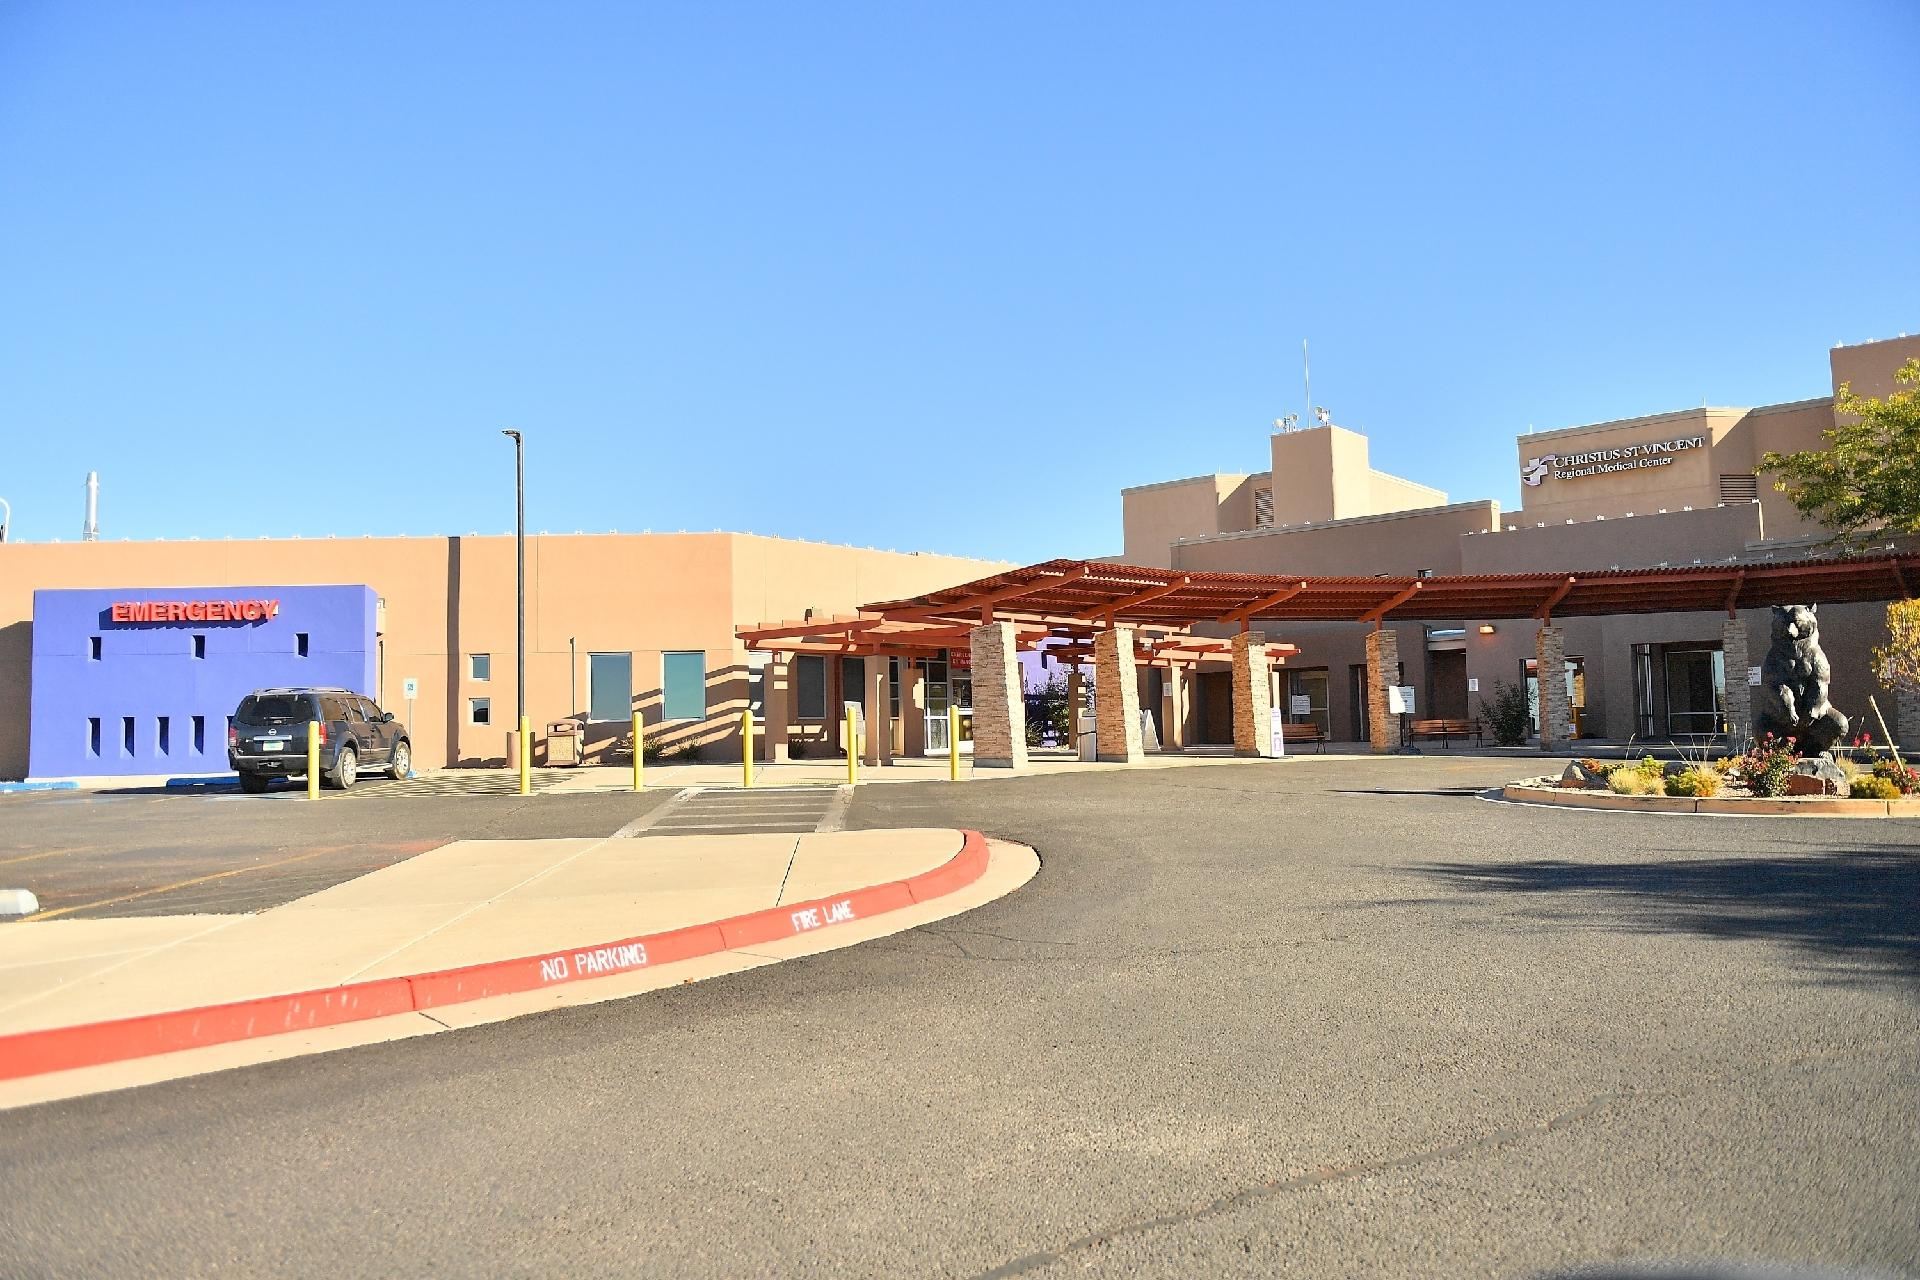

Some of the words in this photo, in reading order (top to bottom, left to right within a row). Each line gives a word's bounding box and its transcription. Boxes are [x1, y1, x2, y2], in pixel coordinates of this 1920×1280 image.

[1553, 449, 1621, 468] CHRISTUS
[1625, 446, 1640, 457] ST
[1641, 437, 1706, 455] VINCENT
[1554, 466, 1595, 480] Regional
[1598, 459, 1637, 474] Medical
[1639, 456, 1673, 468] Center
[111, 599, 279, 621] EMERGENCY
[791, 908, 819, 932] FIRE
[822, 899, 856, 924] LANE
[540, 956, 569, 981] NO
[575, 943, 647, 974] PARKING
